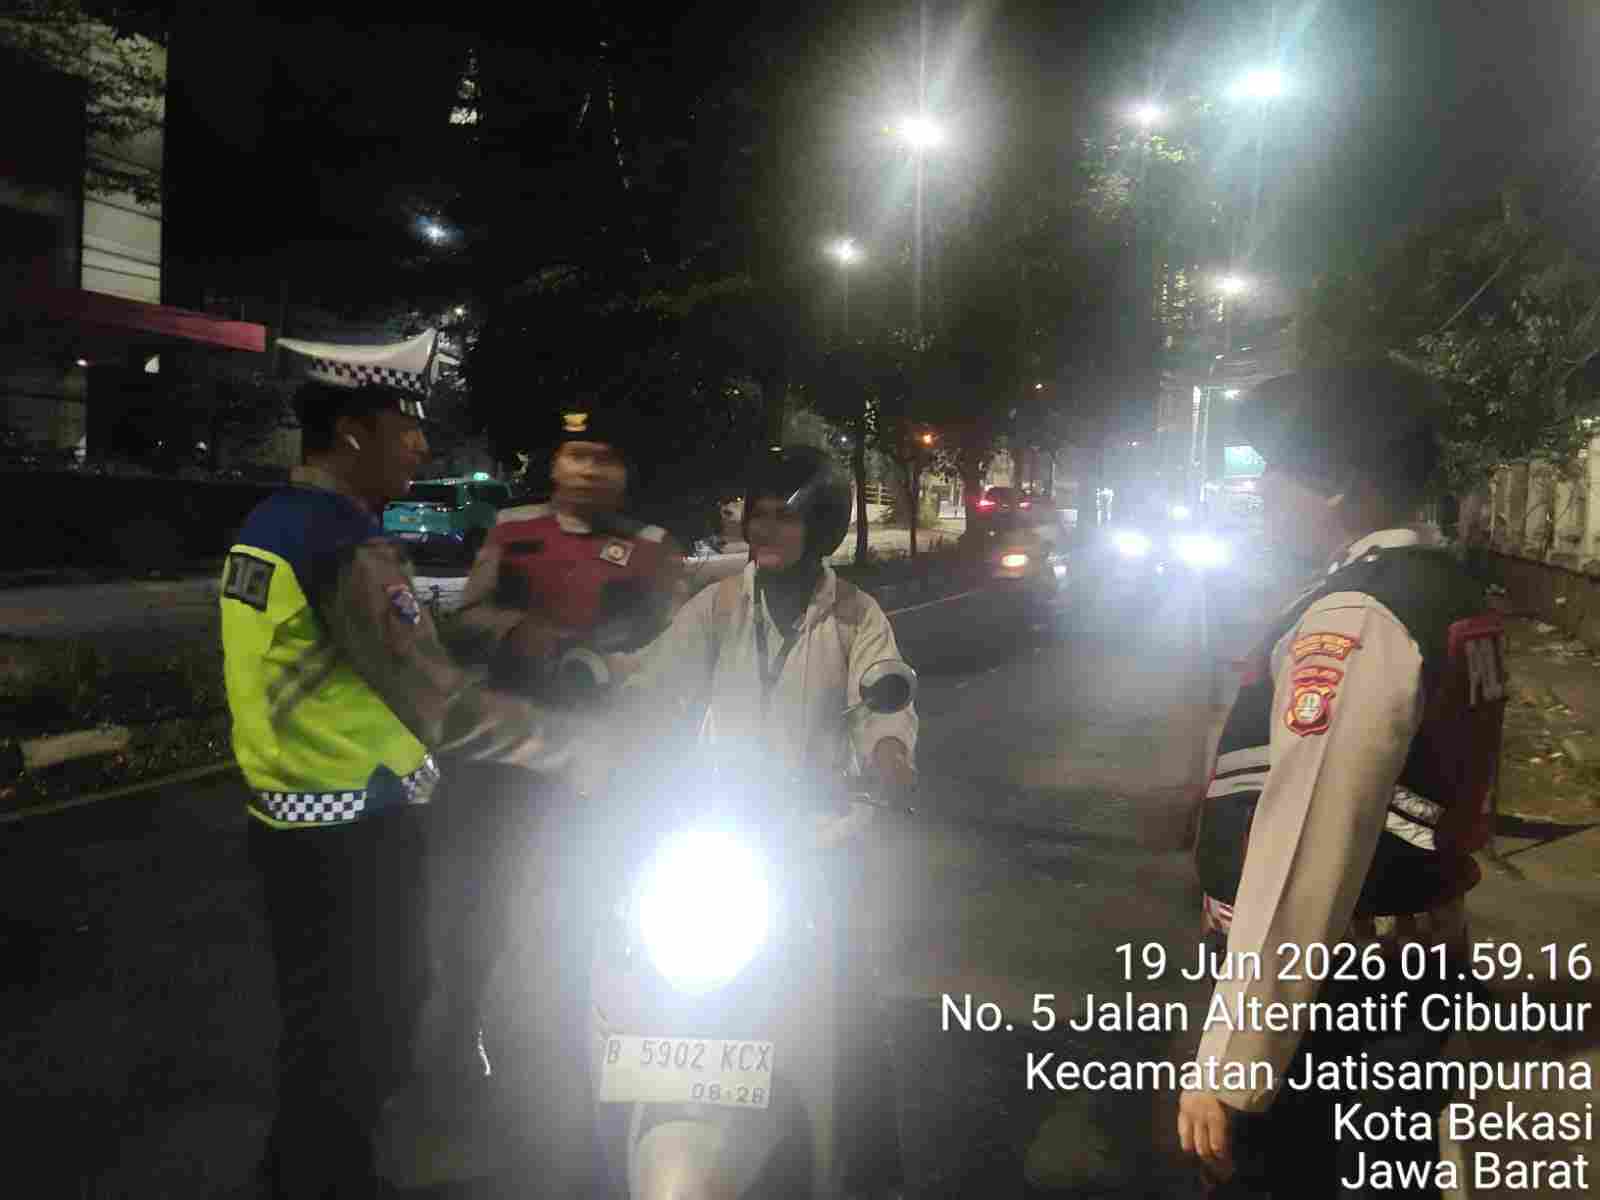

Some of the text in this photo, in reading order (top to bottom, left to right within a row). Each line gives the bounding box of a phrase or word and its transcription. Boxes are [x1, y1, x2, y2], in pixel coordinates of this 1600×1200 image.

[607, 1039, 770, 1073] B 5902 KCX
